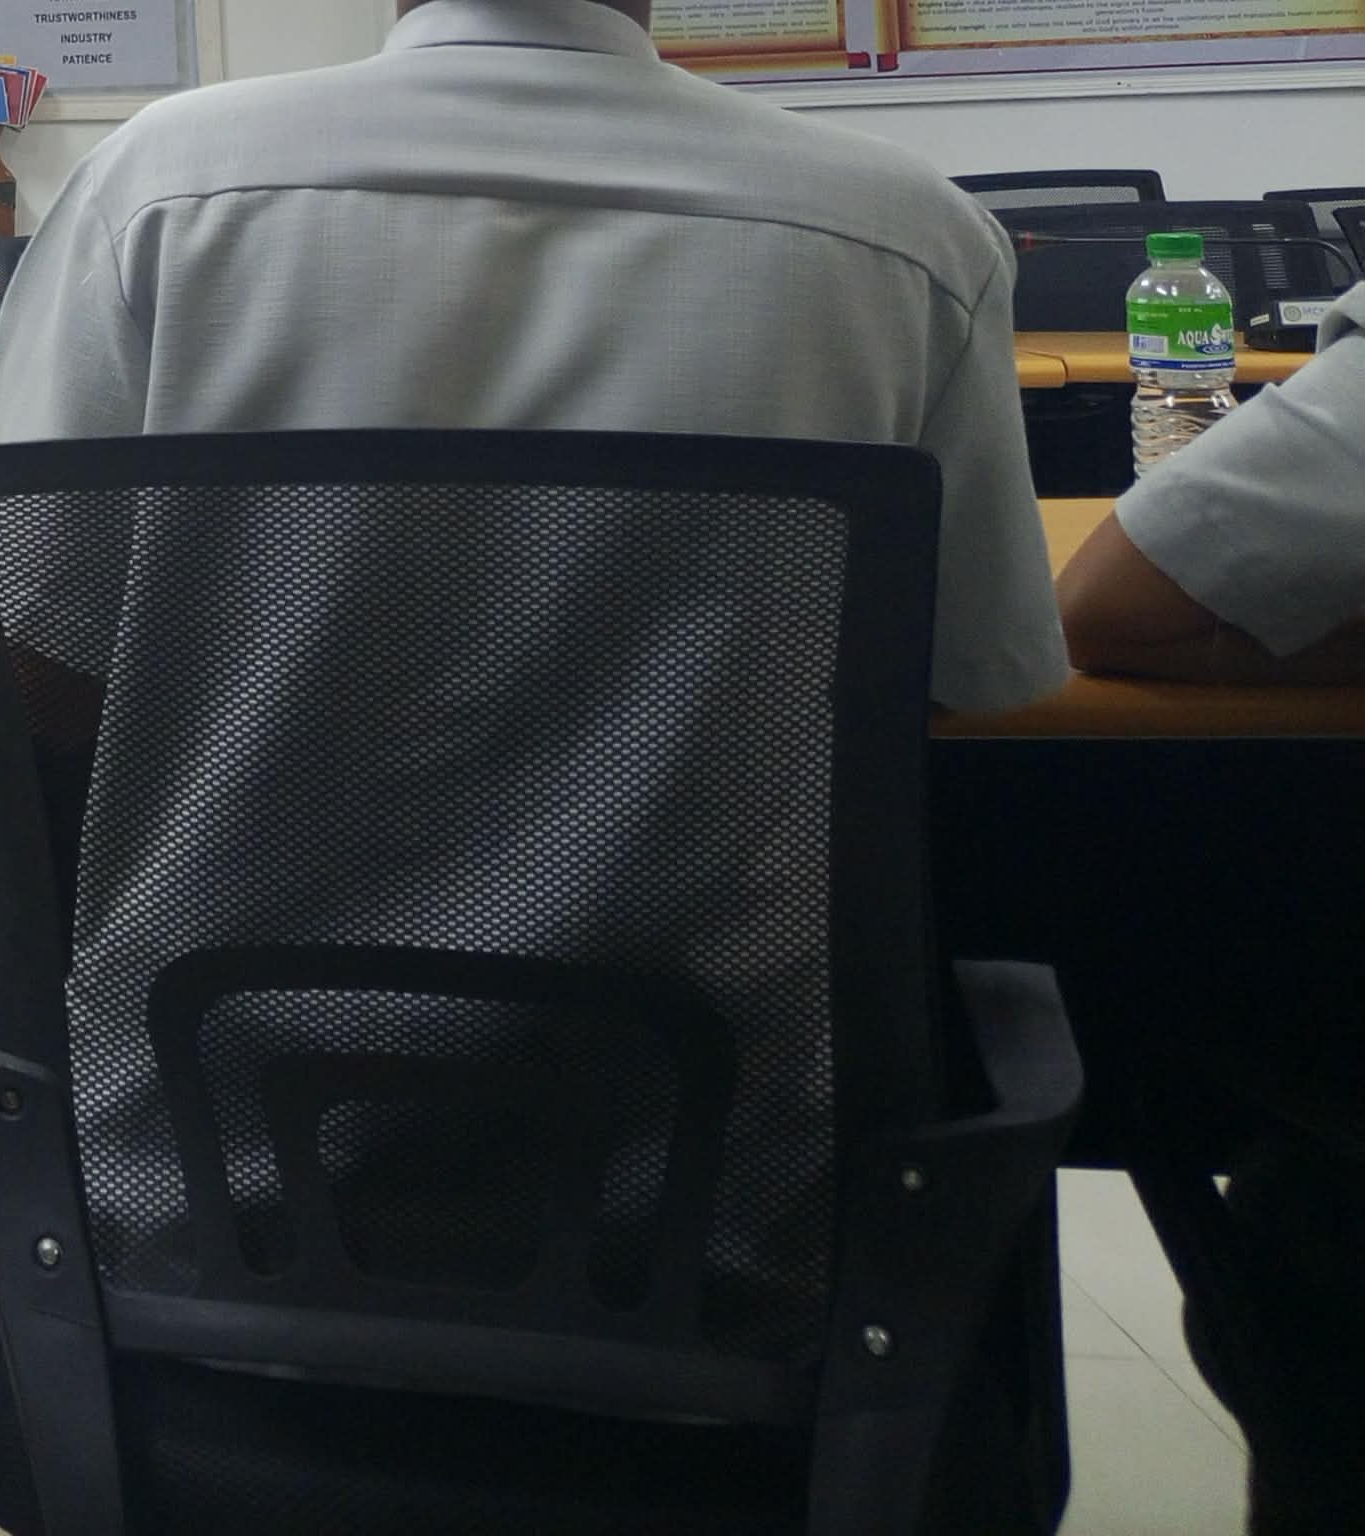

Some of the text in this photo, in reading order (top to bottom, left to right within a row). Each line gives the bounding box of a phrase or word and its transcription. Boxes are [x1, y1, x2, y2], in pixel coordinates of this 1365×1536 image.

[34, 10, 137, 23] TRUSTWORTHINESS
[60, 33, 112, 44] INDUSTRY
[62, 54, 113, 64] PATIENCE
[1178, 330, 1209, 349] AQUA
